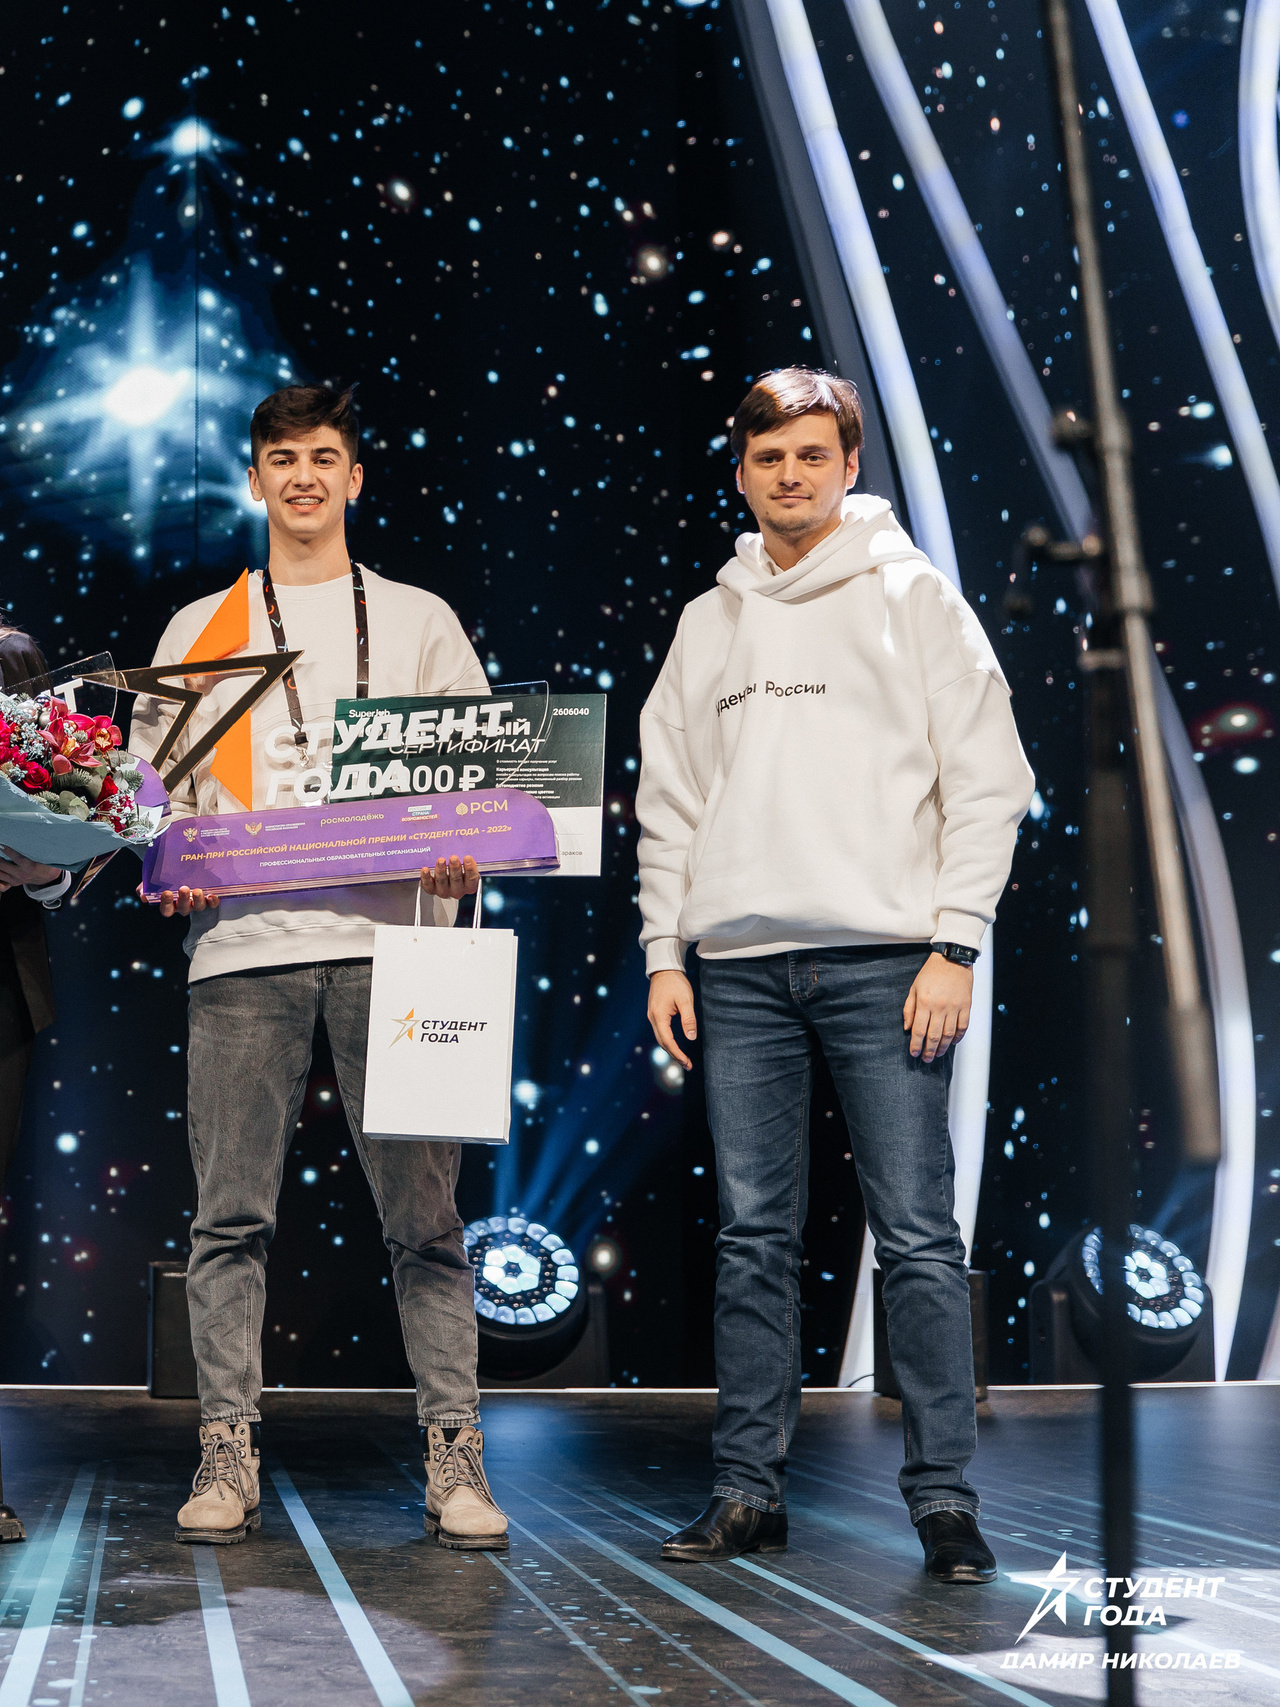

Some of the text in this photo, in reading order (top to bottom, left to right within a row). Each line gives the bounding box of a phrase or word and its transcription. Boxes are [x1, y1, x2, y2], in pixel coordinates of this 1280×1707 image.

[765, 680, 826, 697] России
[553, 708, 589, 716] 2606040
[470, 799, 508, 814] РСМ
[320, 814, 384, 827] росмолодёжь
[180, 851, 225, 862] ГРАН-ПРИ
[226, 844, 287, 857] РОССИЙСКОЙ
[289, 837, 366, 852] НАЦИОНАЛЬНОЙ
[368, 834, 407, 844] ПРЕМИИ
[408, 830, 454, 840] «СТУДЕНТ
[455, 827, 479, 836] ГОДА
[487, 825, 512, 834] 2022»
[260, 846, 431, 867] ПРОФЕССИОНАЛЬНЫХ ОБРАЗОВАТЕЛЬНЫХ ОРГАНИЗАЦИЙ
[422, 1020, 487, 1031] СТУДЕНТ
[420, 1033, 459, 1043] ГОДА
